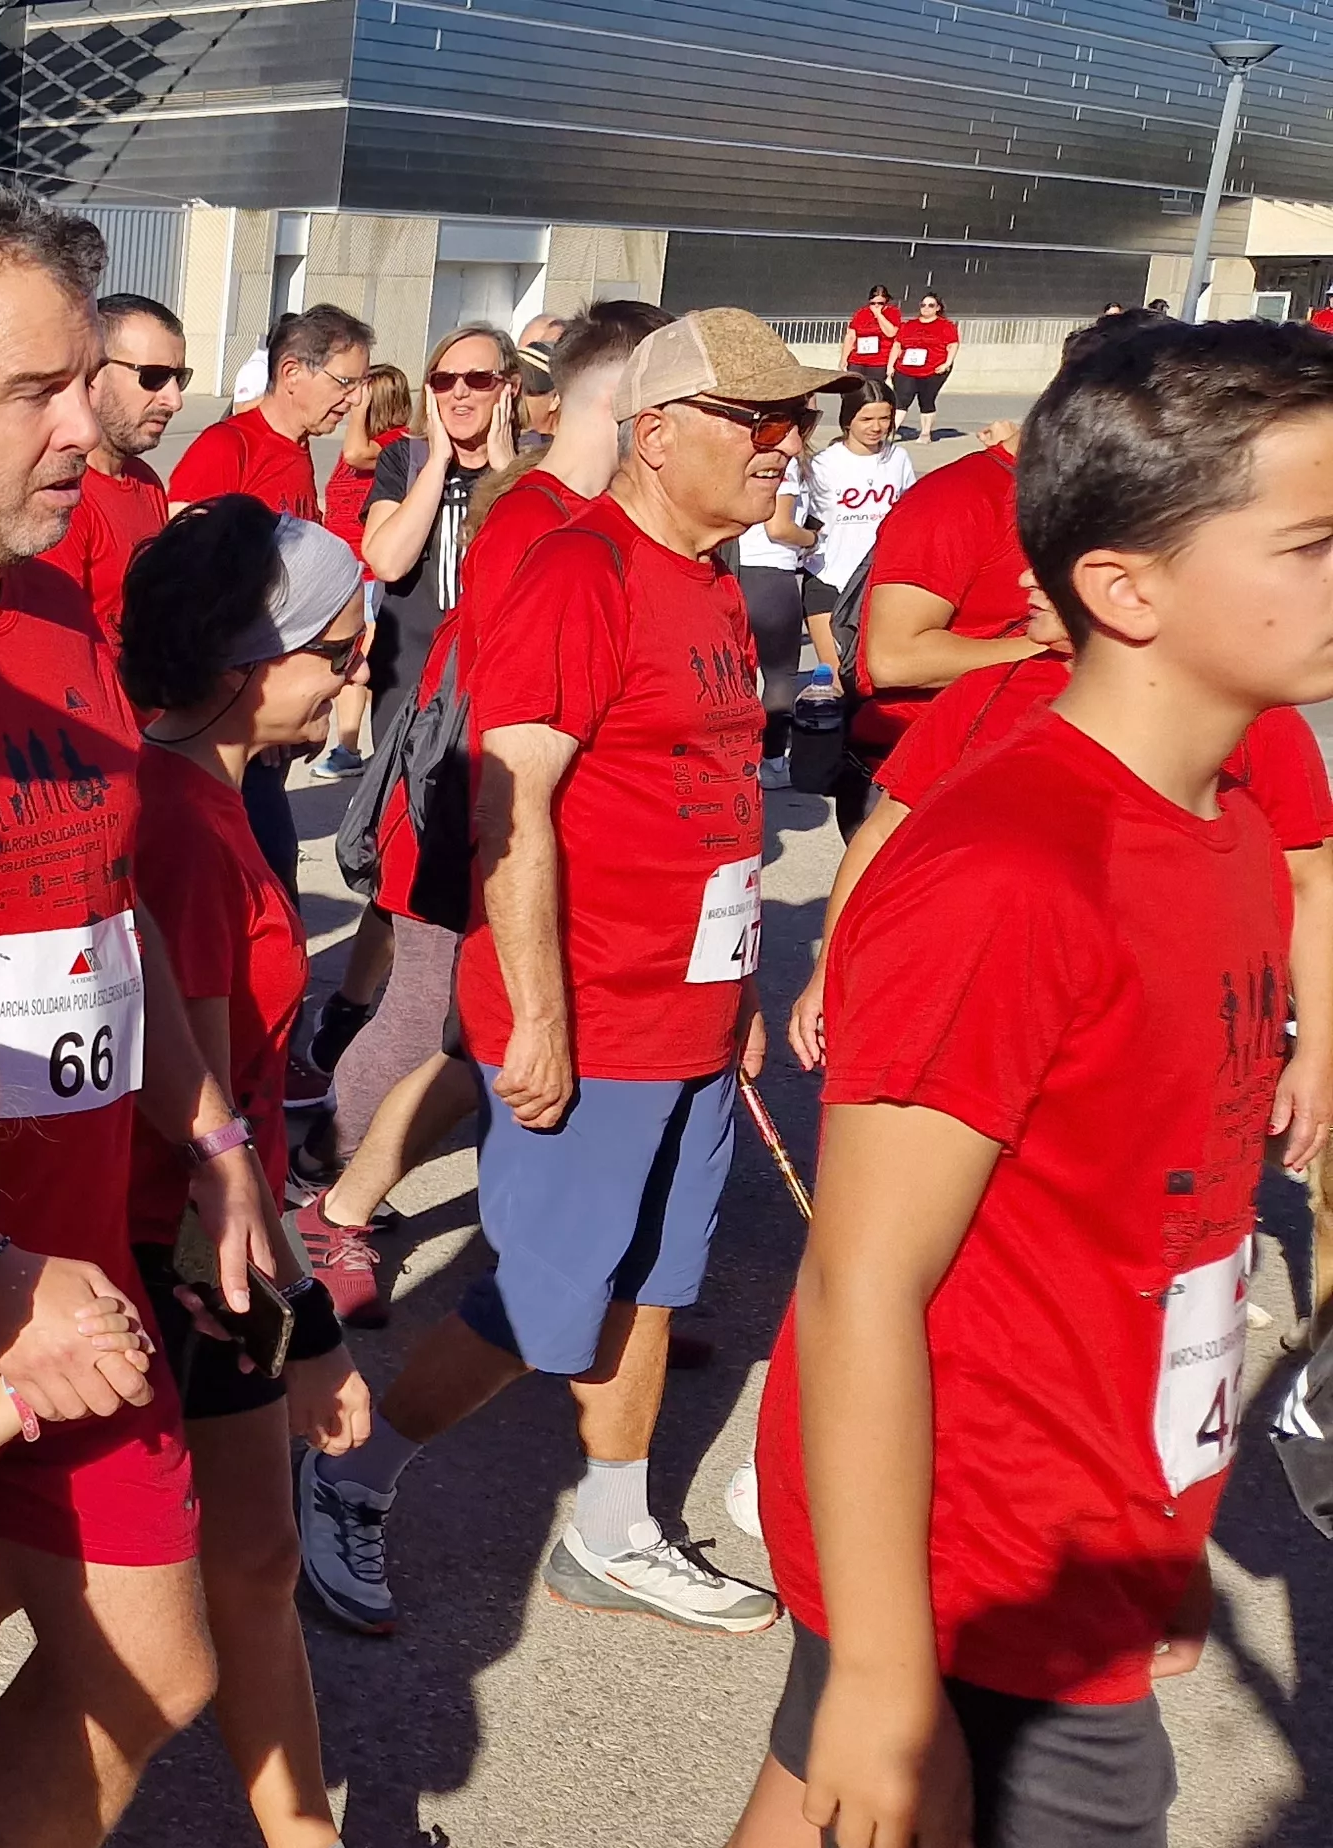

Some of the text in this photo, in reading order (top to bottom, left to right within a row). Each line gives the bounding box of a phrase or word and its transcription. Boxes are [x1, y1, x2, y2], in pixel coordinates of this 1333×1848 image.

[40, 822, 91, 846] SOLIDARIA
[31, 995, 72, 1016] SOLIDARIA
[73, 992, 88, 1011] POR
[49, 1024, 114, 1098] 66
